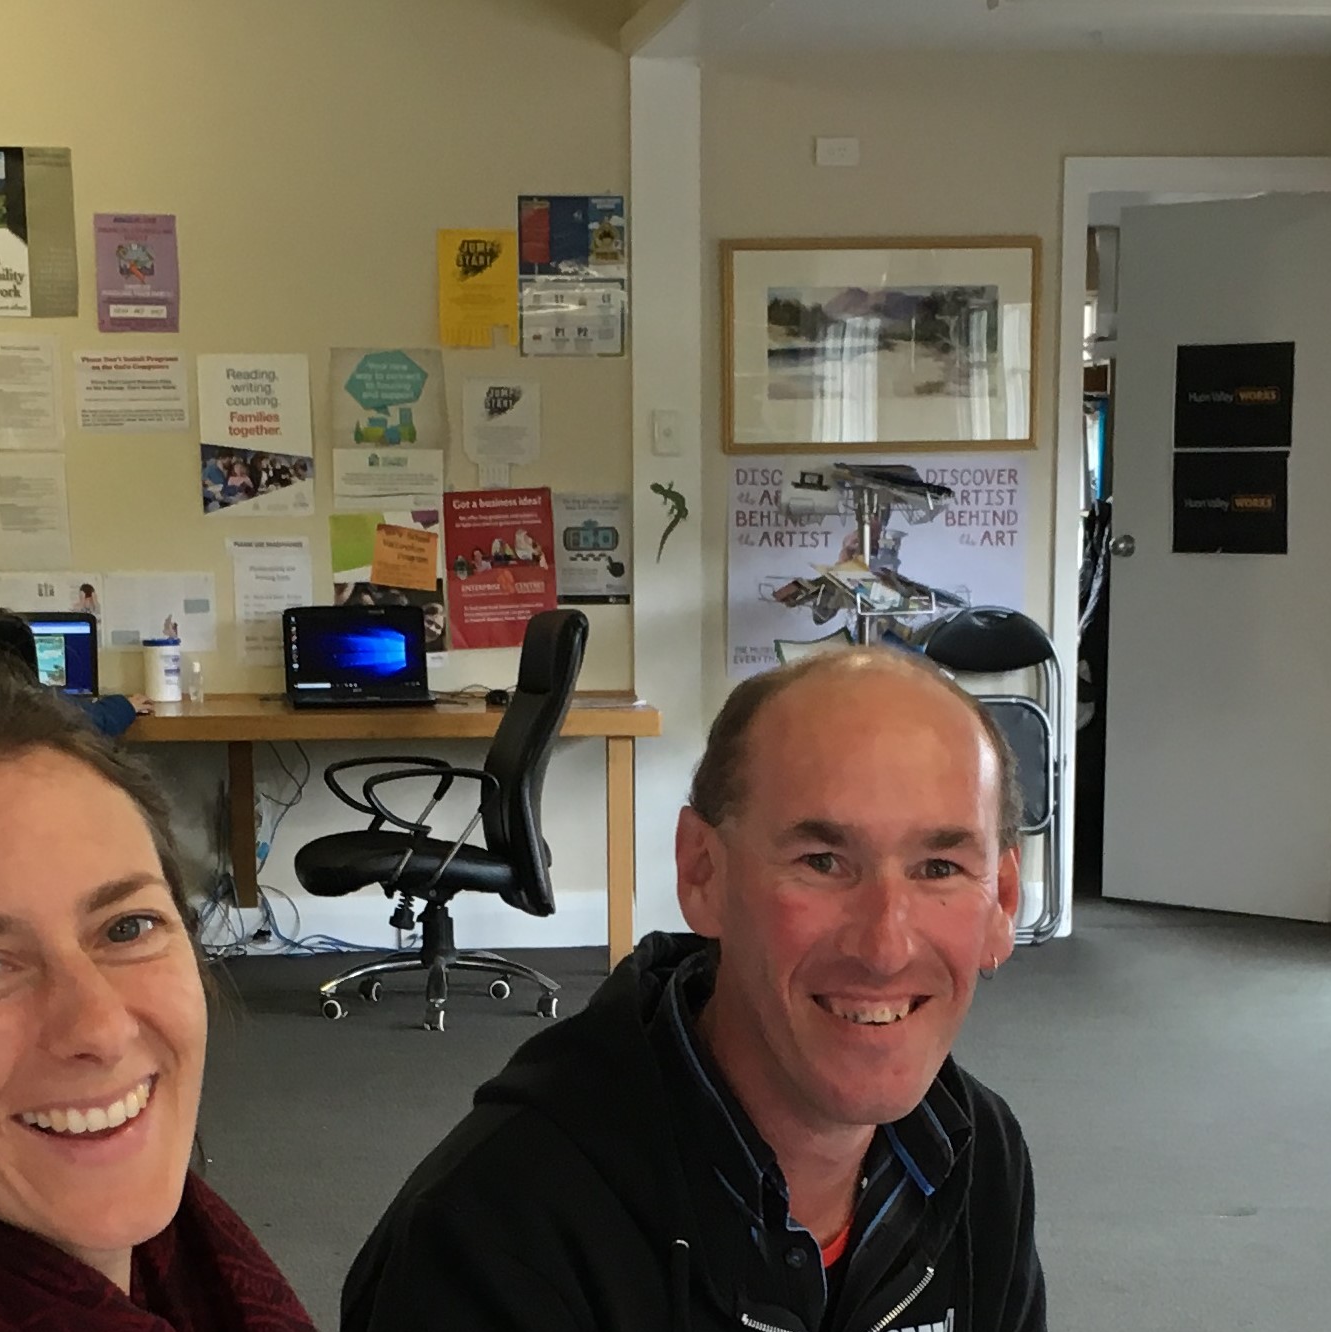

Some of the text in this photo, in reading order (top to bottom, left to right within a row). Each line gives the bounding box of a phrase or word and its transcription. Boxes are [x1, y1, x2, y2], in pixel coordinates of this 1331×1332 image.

[457, 252, 492, 267] START
[1188, 390, 1277, 403] Huon Valley WORKS
[229, 411, 280, 423] Families
[228, 425, 283, 438] together.
[926, 468, 1018, 485] DISCOVER
[453, 501, 470, 509] Got
[479, 498, 517, 508] business
[1208, 498, 1230, 511] Valley
[1234, 498, 1272, 508] WORKS
[945, 511, 1018, 527] BEHIND
[758, 531, 832, 548] ARTIST
[980, 531, 1018, 547] ART
